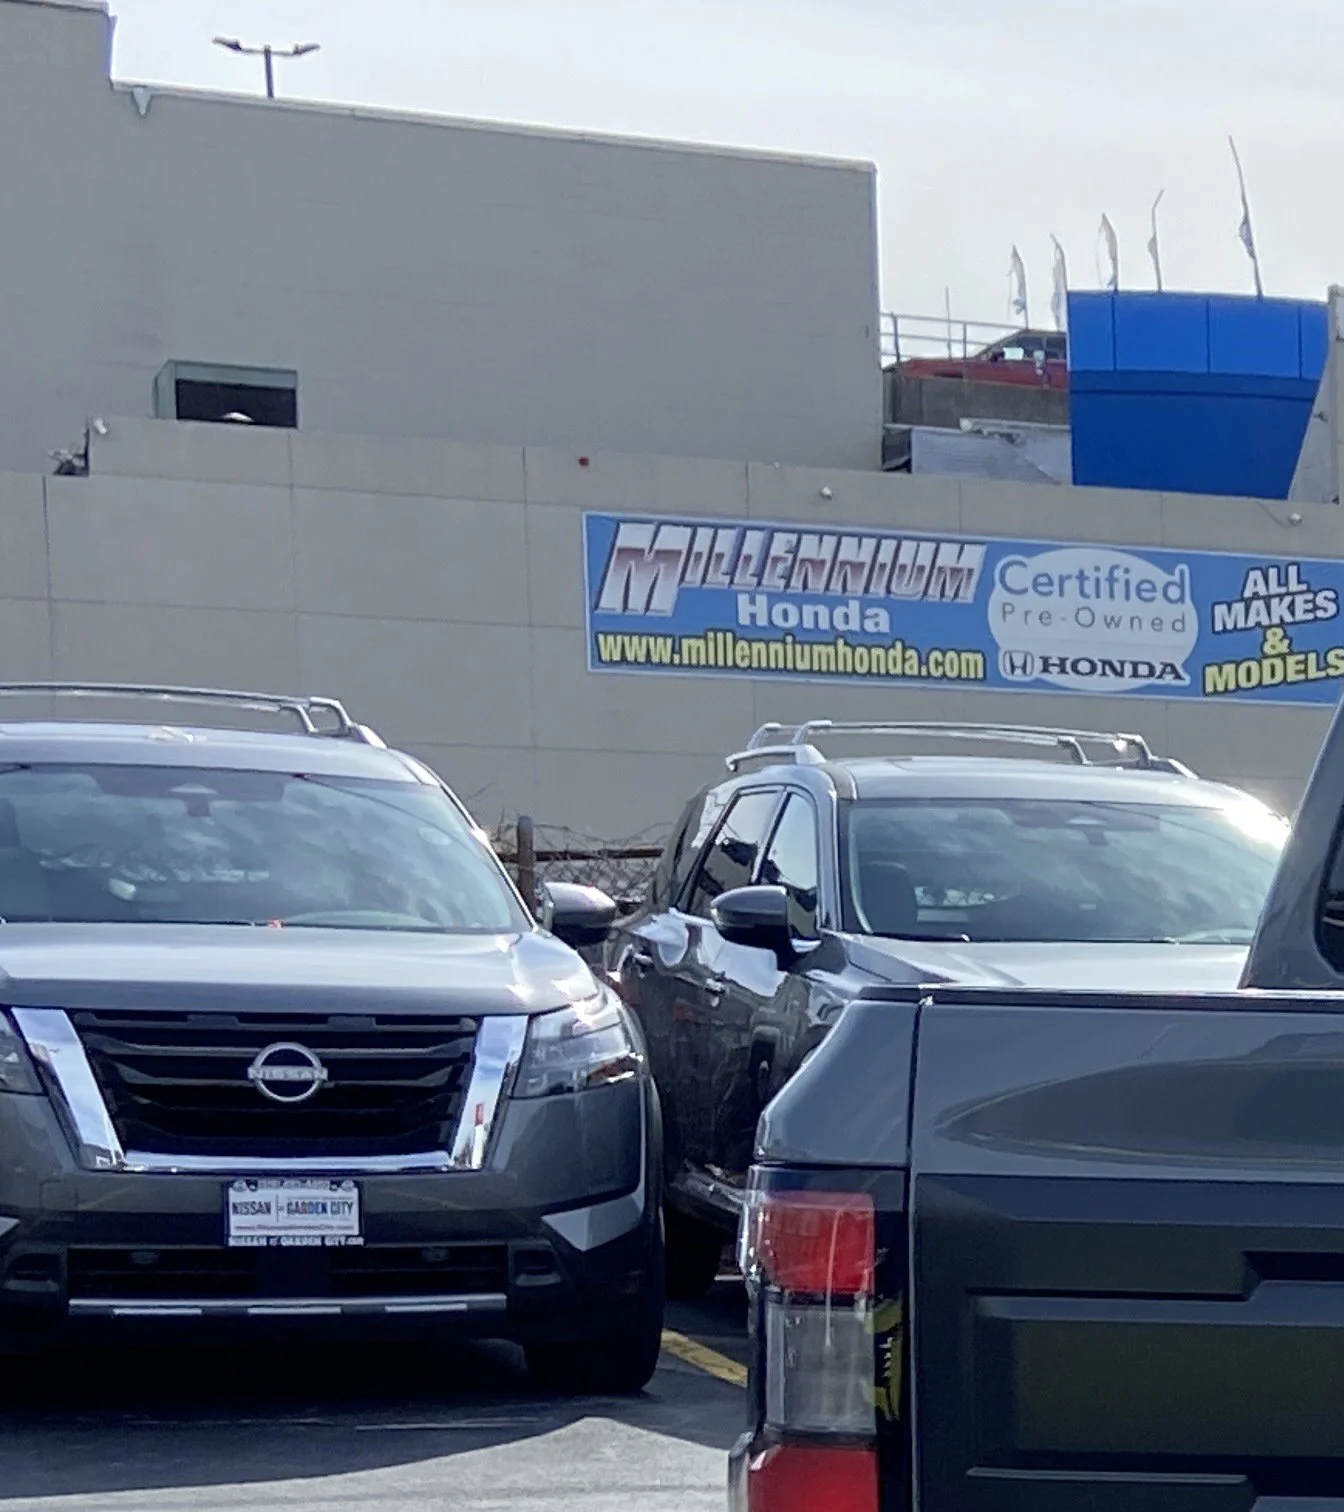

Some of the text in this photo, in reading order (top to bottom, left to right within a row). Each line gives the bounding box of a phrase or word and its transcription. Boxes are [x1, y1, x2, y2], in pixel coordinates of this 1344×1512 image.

[595, 520, 989, 617] MILLENNIUM
[999, 560, 1187, 605] Certified
[1243, 565, 1310, 599] ALL
[736, 592, 891, 635] Honda
[1001, 602, 1187, 633] Pre-Owned
[1213, 590, 1339, 633] MAKES
[597, 628, 988, 681] www.millenniumhonda.com
[1263, 626, 1292, 656] &
[1038, 655, 1187, 681] HONDA
